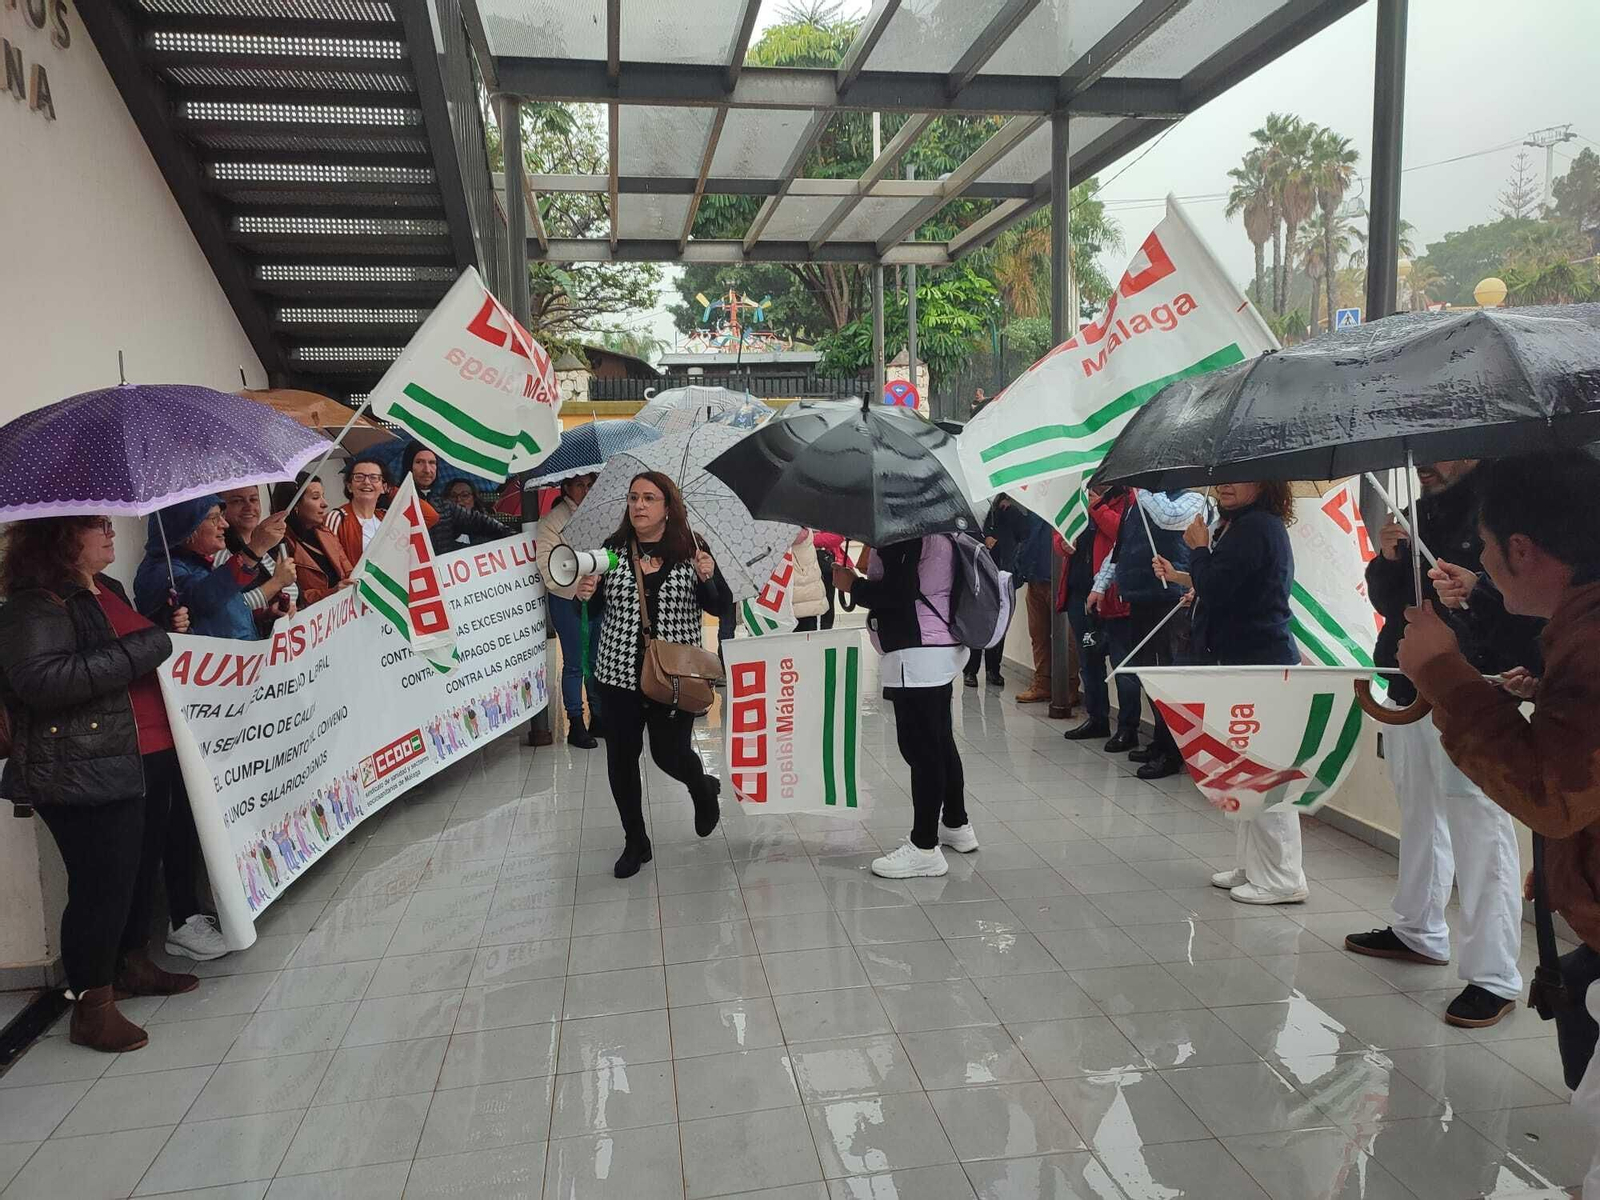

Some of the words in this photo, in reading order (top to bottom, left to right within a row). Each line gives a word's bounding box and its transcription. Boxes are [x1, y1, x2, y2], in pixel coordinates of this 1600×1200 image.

[474, 549, 508, 578] EN
[510, 540, 537, 567] LU
[463, 582, 513, 607] ATENCIÓN
[514, 579, 522, 590] A
[522, 573, 540, 587] LOS
[471, 604, 524, 631] EXCESIVAS
[525, 600, 537, 612] DE
[498, 634, 512, 647] DE
[513, 627, 531, 642] LAS
[446, 669, 484, 694] CONTRA
[484, 661, 503, 678] LAS
[776, 657, 798, 734] Málaga
[277, 716, 293, 735] DE
[224, 738, 310, 787] CUMPLIMIENTO
[375, 739, 414, 773] CCOO
[260, 771, 306, 808] SALARIOS
